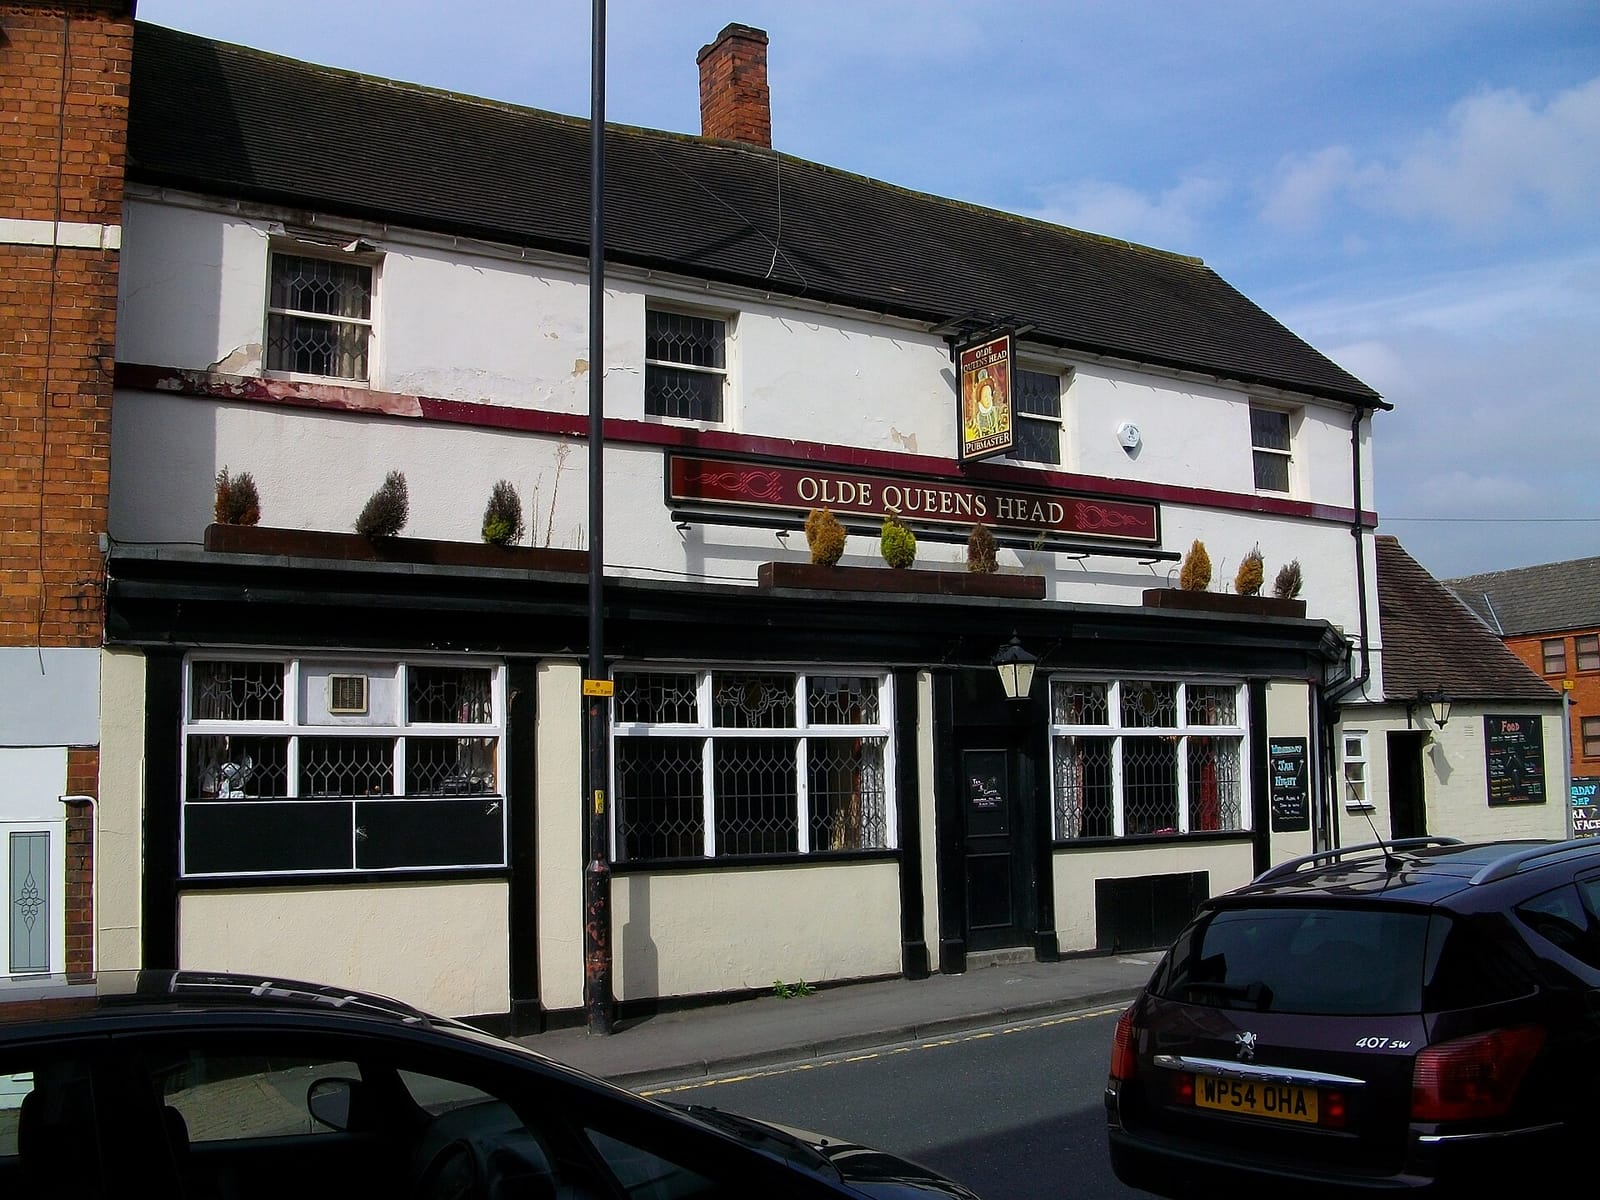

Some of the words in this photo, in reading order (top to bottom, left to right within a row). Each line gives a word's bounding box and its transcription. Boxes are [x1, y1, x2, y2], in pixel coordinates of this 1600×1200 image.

[975, 345, 993, 359] OLDE
[988, 350, 1007, 363] HEAD
[966, 432, 1010, 453] PUBMASTER
[796, 476, 873, 506] OLDE
[881, 485, 987, 517] QUEENS
[995, 496, 1064, 524] HEAD
[1355, 1036, 1389, 1049] 407
[1204, 1078, 1257, 1109] WP54
[1263, 1086, 1307, 1116] OHA
